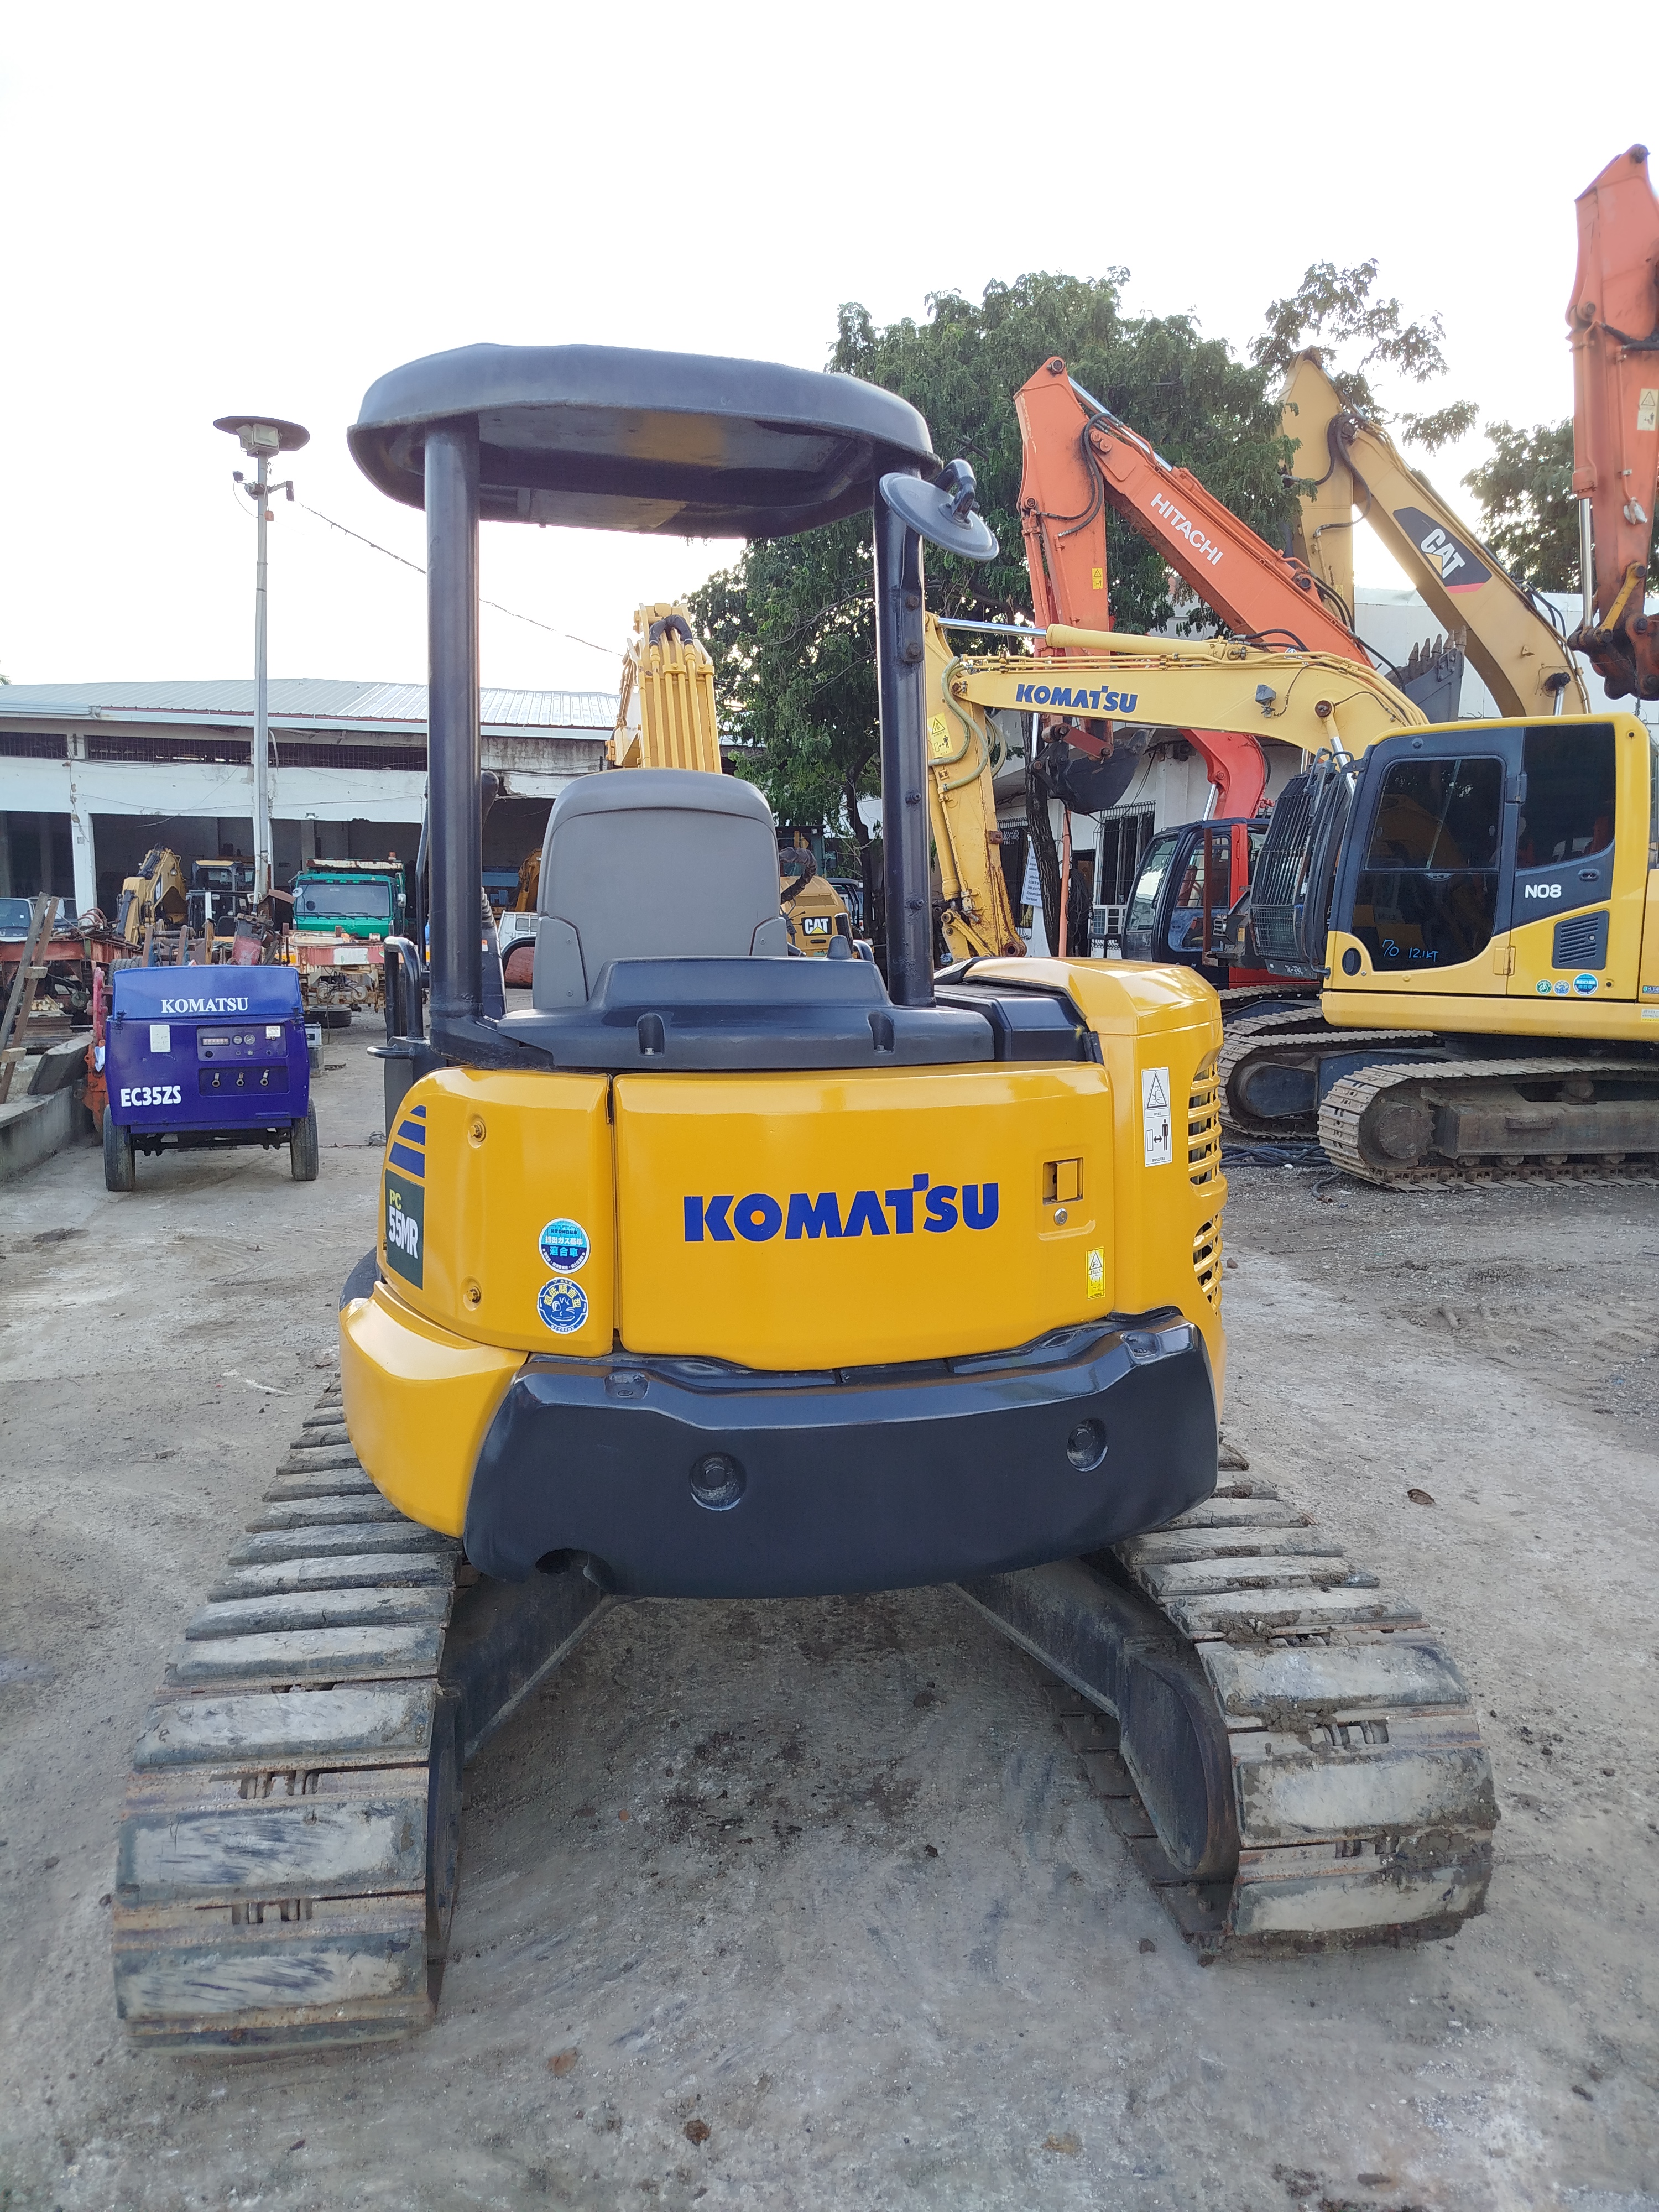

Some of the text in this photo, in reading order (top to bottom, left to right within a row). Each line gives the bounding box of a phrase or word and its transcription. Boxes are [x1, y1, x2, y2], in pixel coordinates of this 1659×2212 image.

[1150, 493, 1223, 565] HITACHI
[1421, 529, 1465, 579] CAT
[1015, 684, 1138, 713] KOMATSU
[804, 917, 829, 935] CAT
[160, 997, 249, 1014] KOMATSU
[121, 1085, 182, 1107] EC35ZS
[389, 1188, 402, 1211] PC
[684, 1173, 999, 1243] KOMATSU
[388, 1205, 419, 1259] 55MR
[549, 1246, 578, 1258] 適合車
